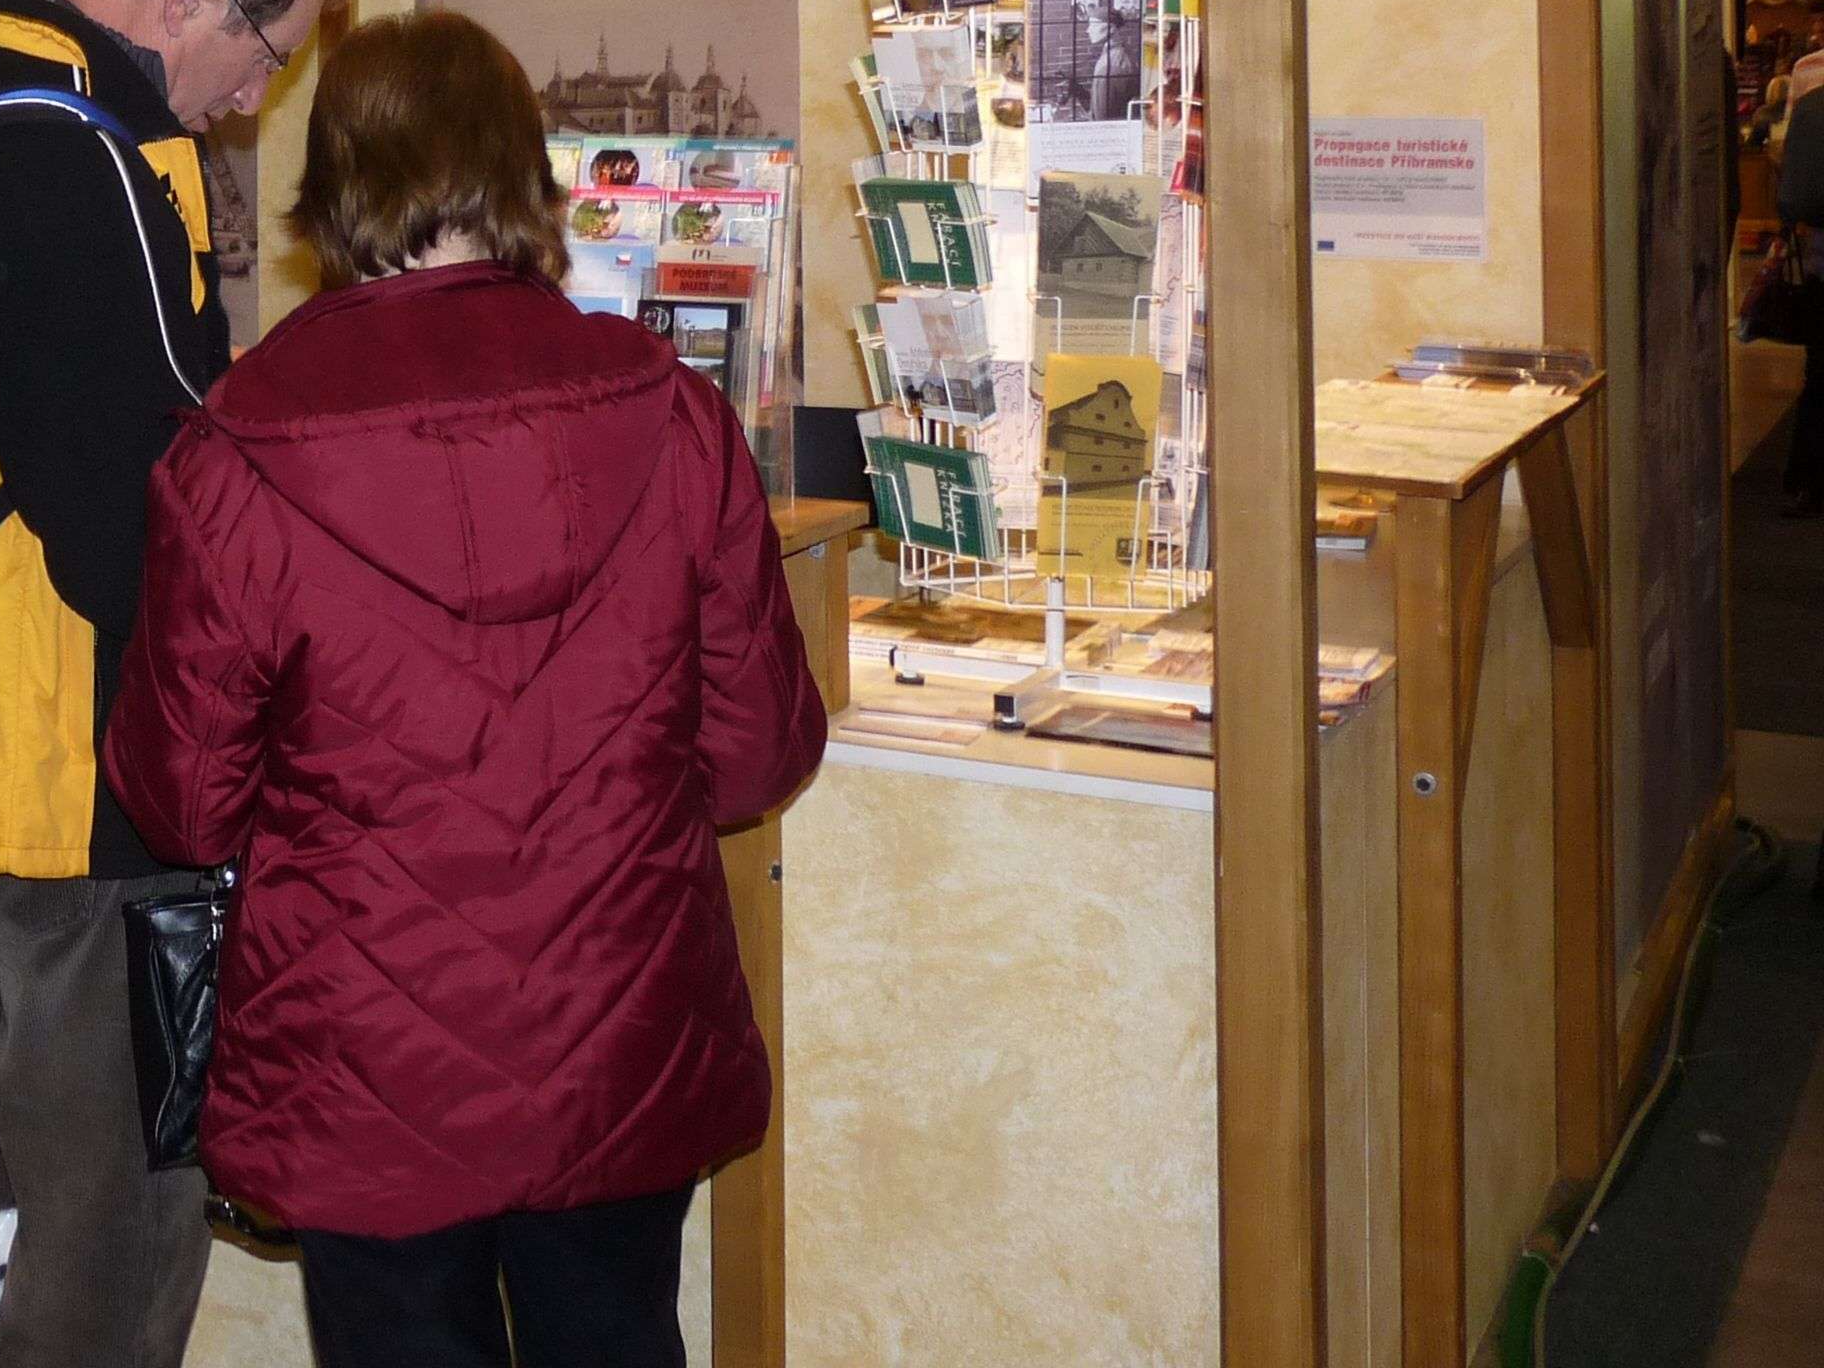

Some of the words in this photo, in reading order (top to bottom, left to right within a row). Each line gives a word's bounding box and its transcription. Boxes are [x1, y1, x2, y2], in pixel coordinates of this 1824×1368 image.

[1314, 138, 1391, 154] Propagace
[1397, 137, 1469, 153] turistické
[1314, 154, 1386, 169] destinace
[1391, 155, 1475, 170] Příbramsko
